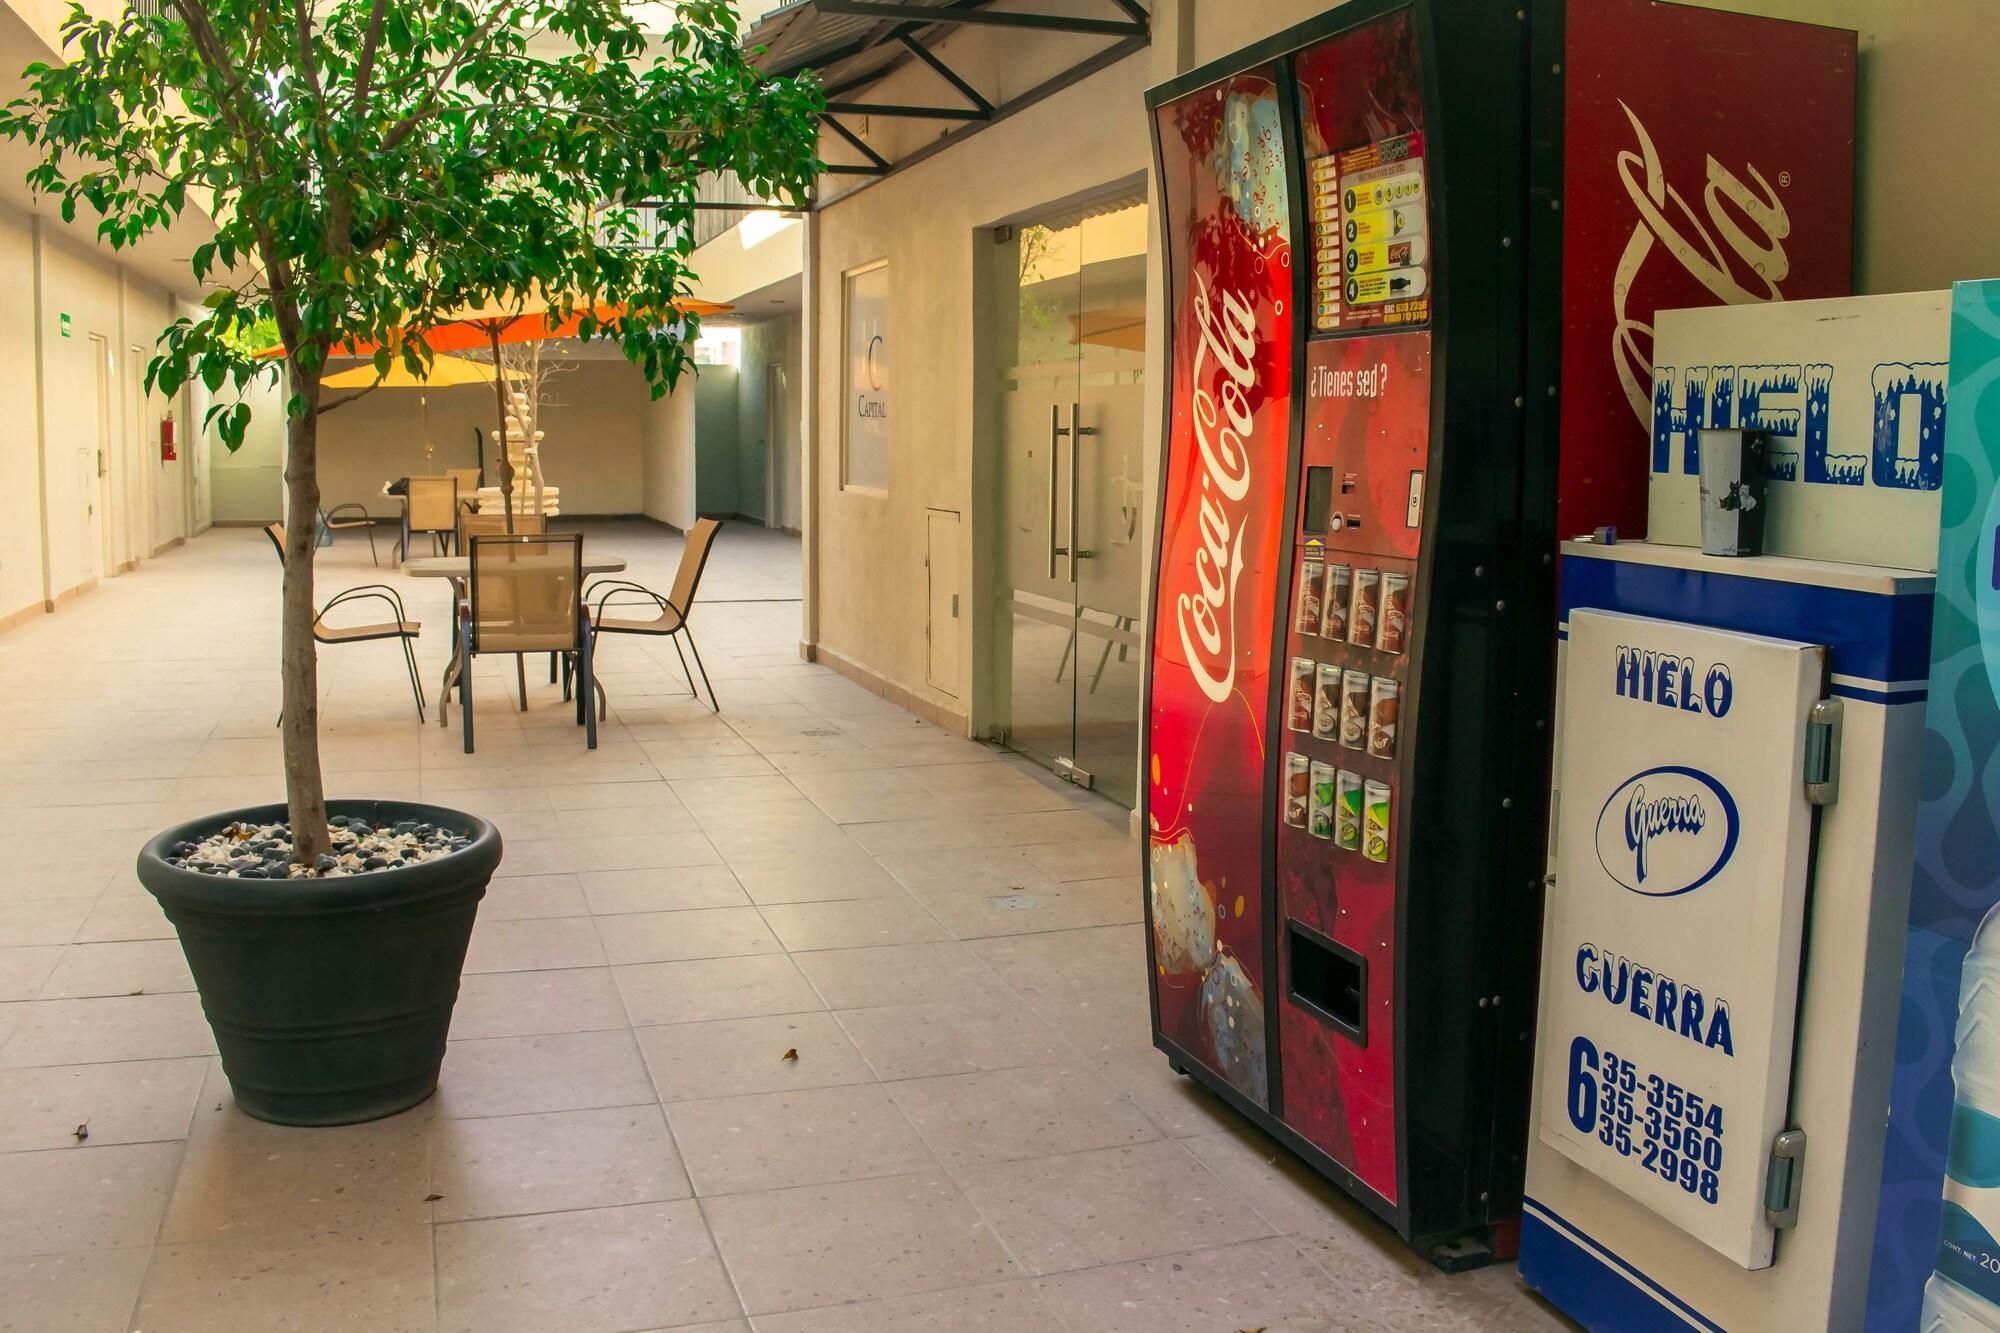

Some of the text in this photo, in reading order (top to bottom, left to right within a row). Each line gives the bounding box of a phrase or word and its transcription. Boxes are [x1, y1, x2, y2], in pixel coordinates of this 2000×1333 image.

[1177, 267, 1257, 703] Coca-Cola
[1615, 645, 1733, 718] HIELO
[1624, 783, 1706, 884] Guerra
[1576, 942, 1734, 1057] GUERRA
[1567, 1036, 1599, 1134] 6
[1600, 1083, 1723, 1172] 35-3560
[1602, 1051, 1724, 1139] 35-3554
[1598, 1115, 1719, 1205] 35-2998
